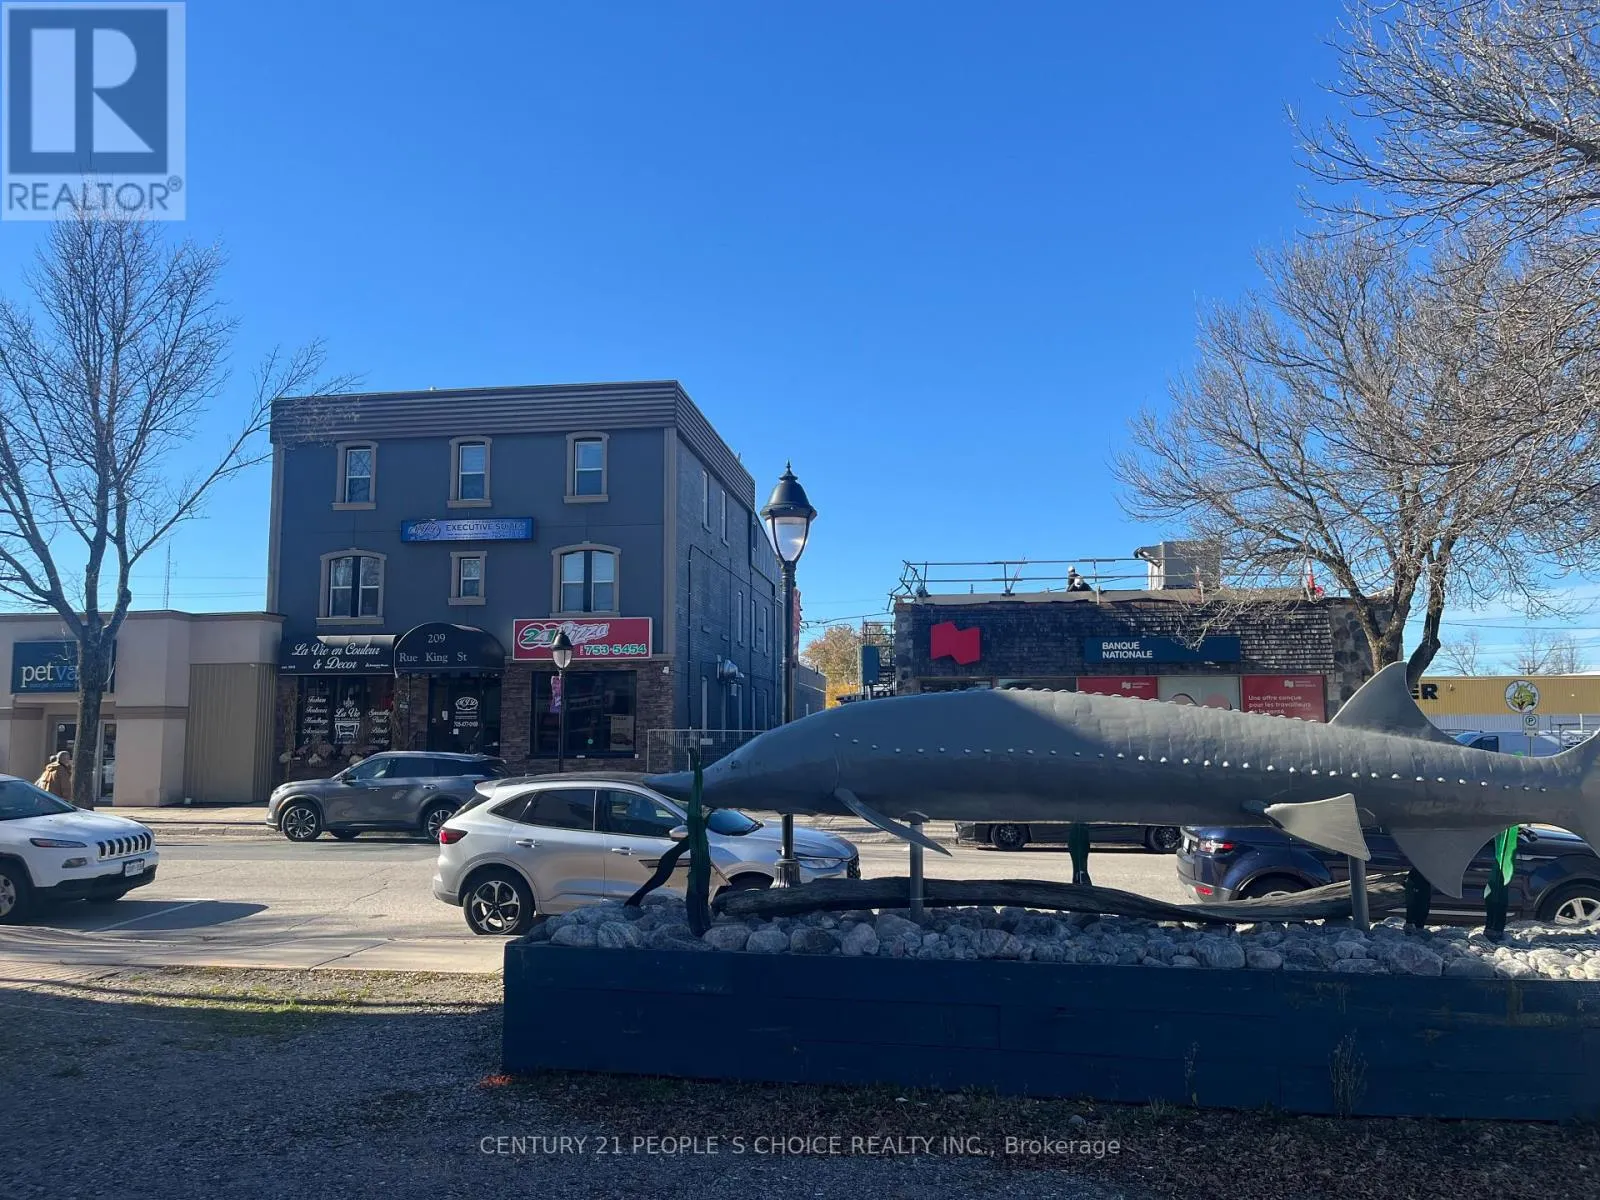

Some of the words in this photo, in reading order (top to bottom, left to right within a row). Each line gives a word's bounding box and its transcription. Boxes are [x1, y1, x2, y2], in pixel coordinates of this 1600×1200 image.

[446, 524, 494, 532] EXECUTIVE
[428, 633, 446, 644] 209
[291, 643, 308, 656] La
[311, 643, 329, 656] Vie
[331, 647, 343, 656] en
[345, 642, 380, 655] Couleur
[1102, 642, 1140, 650] BANQUE
[399, 652, 419, 662] Rue
[425, 652, 448, 664] King
[456, 651, 468, 662] St
[1102, 650, 1153, 658] NATIONALE
[313, 659, 322, 670] &
[324, 656, 358, 670] Decor
